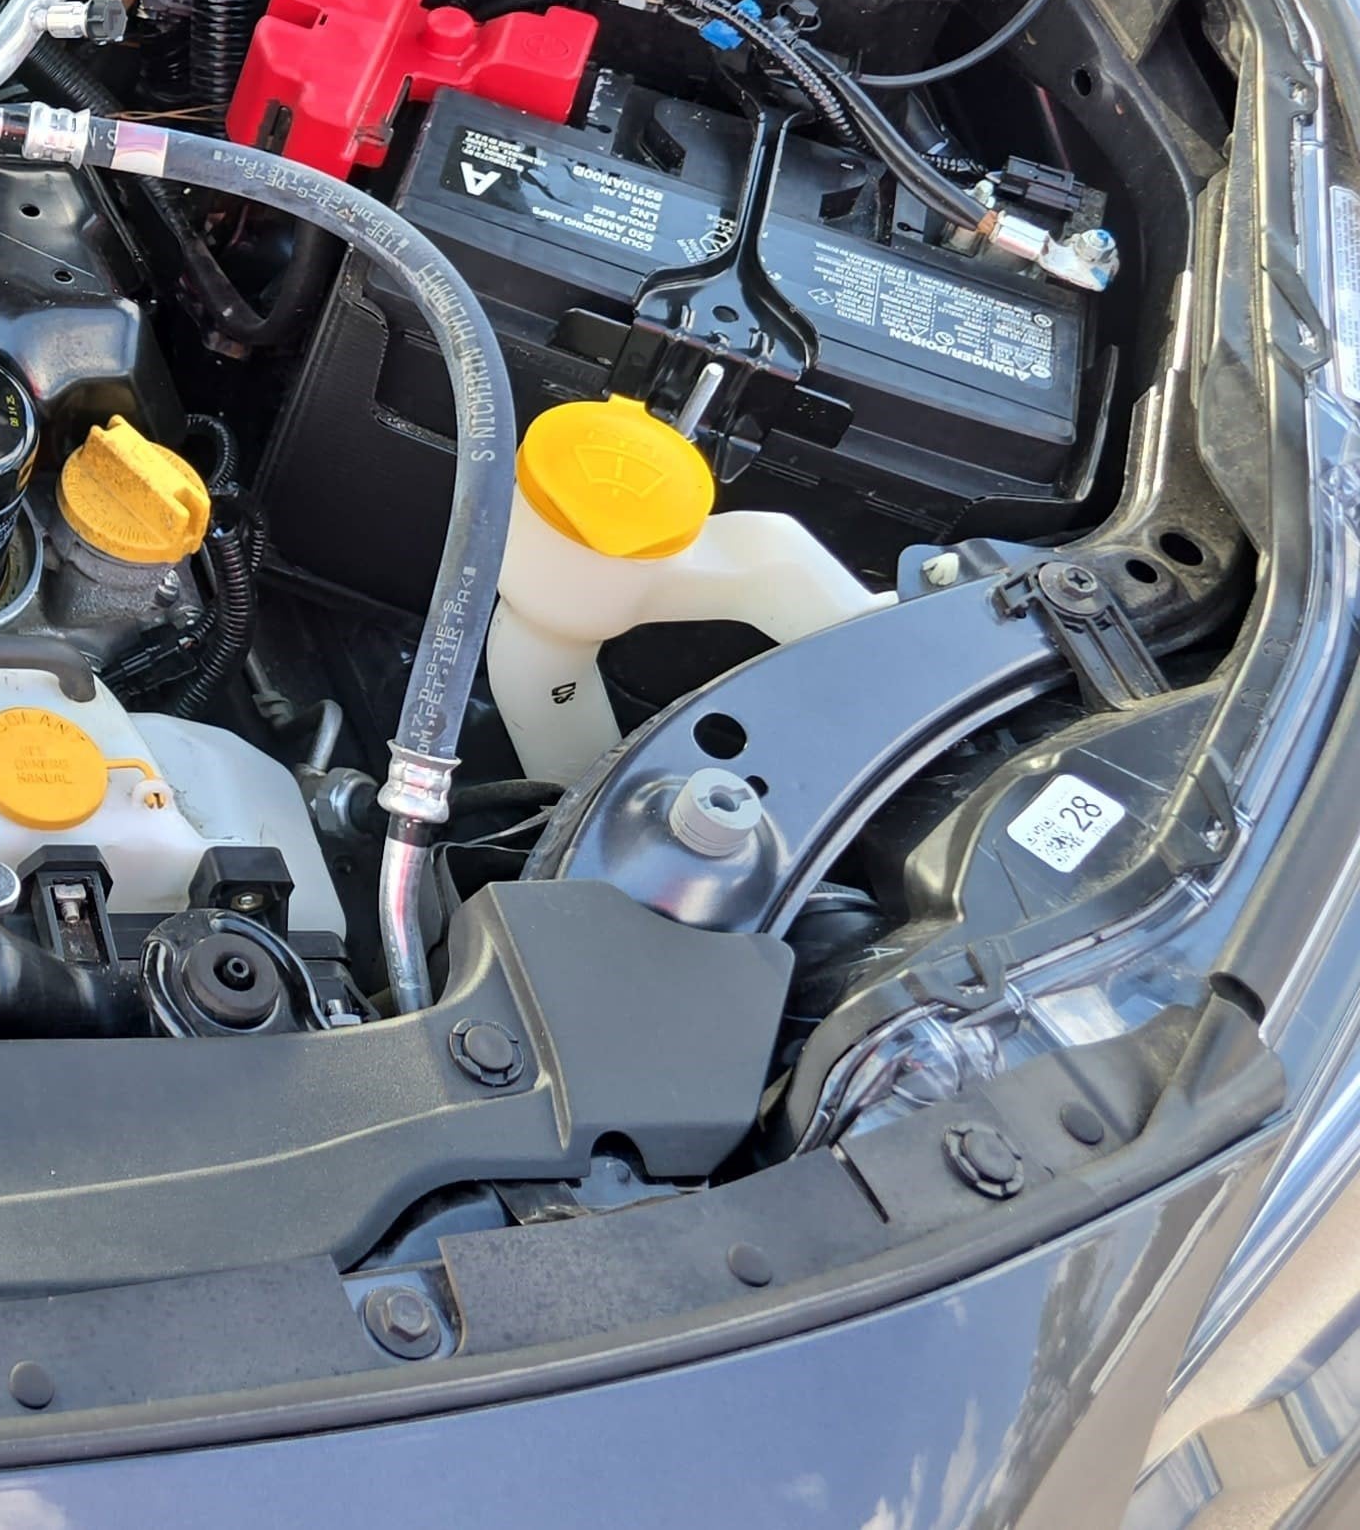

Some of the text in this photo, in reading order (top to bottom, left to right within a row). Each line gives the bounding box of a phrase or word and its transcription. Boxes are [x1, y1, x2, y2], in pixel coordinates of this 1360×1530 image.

[532, 206, 653, 251] COLD CRANKING AMPS
[583, 213, 654, 243] 620 AMPS
[592, 205, 656, 232] GROUP SIZE
[629, 206, 659, 223] LN2
[889, 328, 1016, 377] DANGER/POISON
